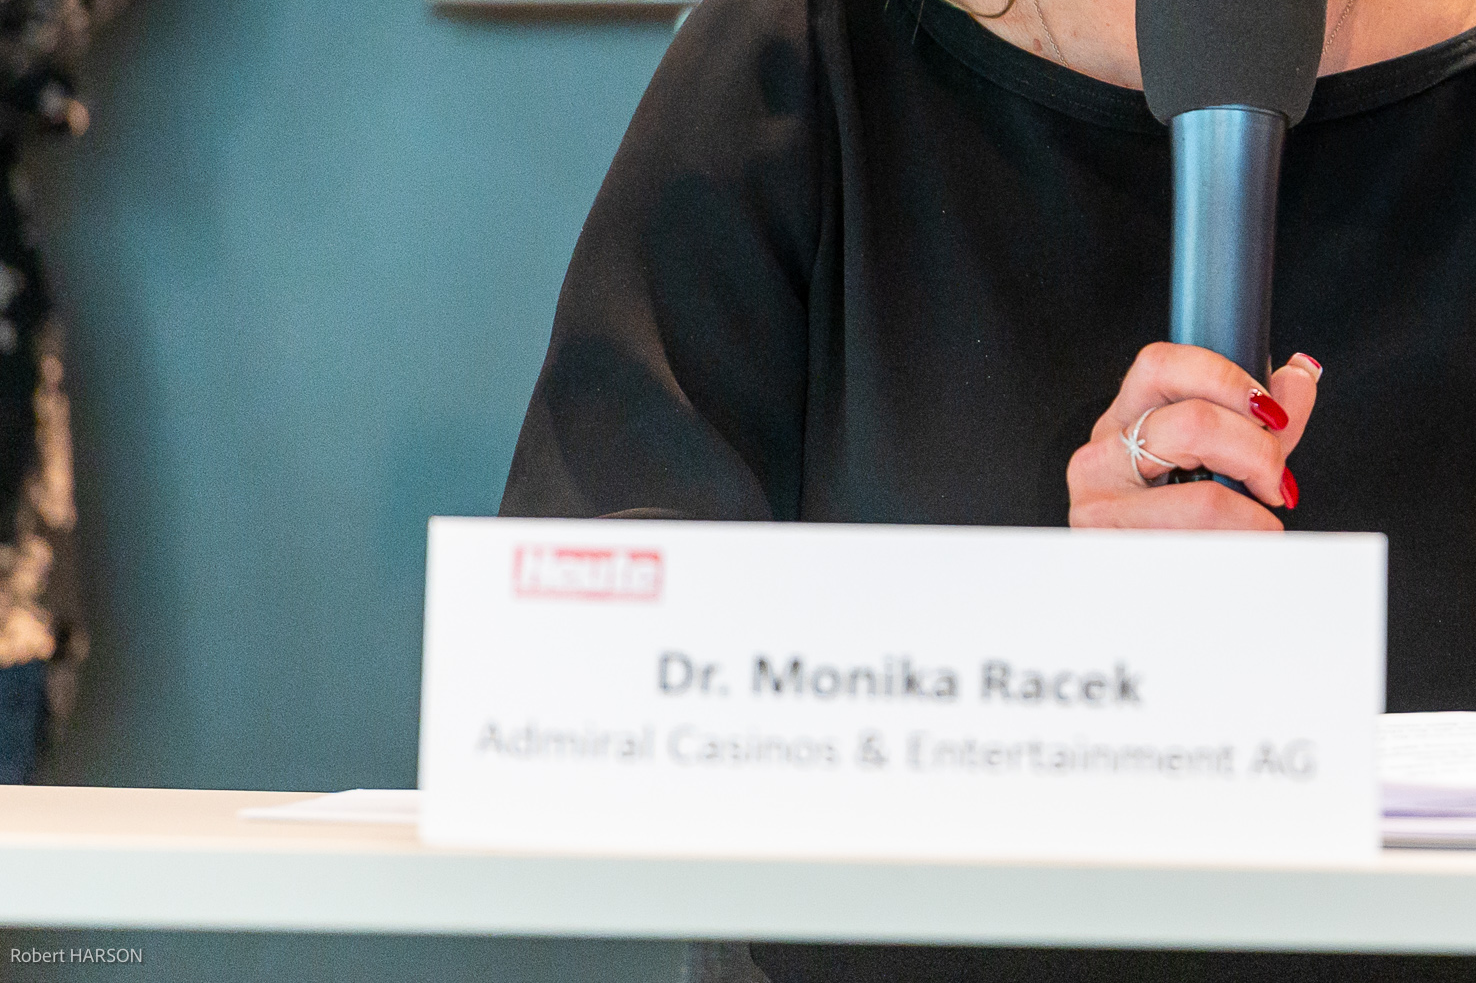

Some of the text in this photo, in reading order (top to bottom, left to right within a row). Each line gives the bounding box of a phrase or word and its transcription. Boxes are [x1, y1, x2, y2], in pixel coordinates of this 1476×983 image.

[520, 549, 658, 596] Heute
[657, 651, 1144, 706] Dr. Monika Racek
[476, 719, 1318, 780] Admiral Casinos & Entertainment AG
